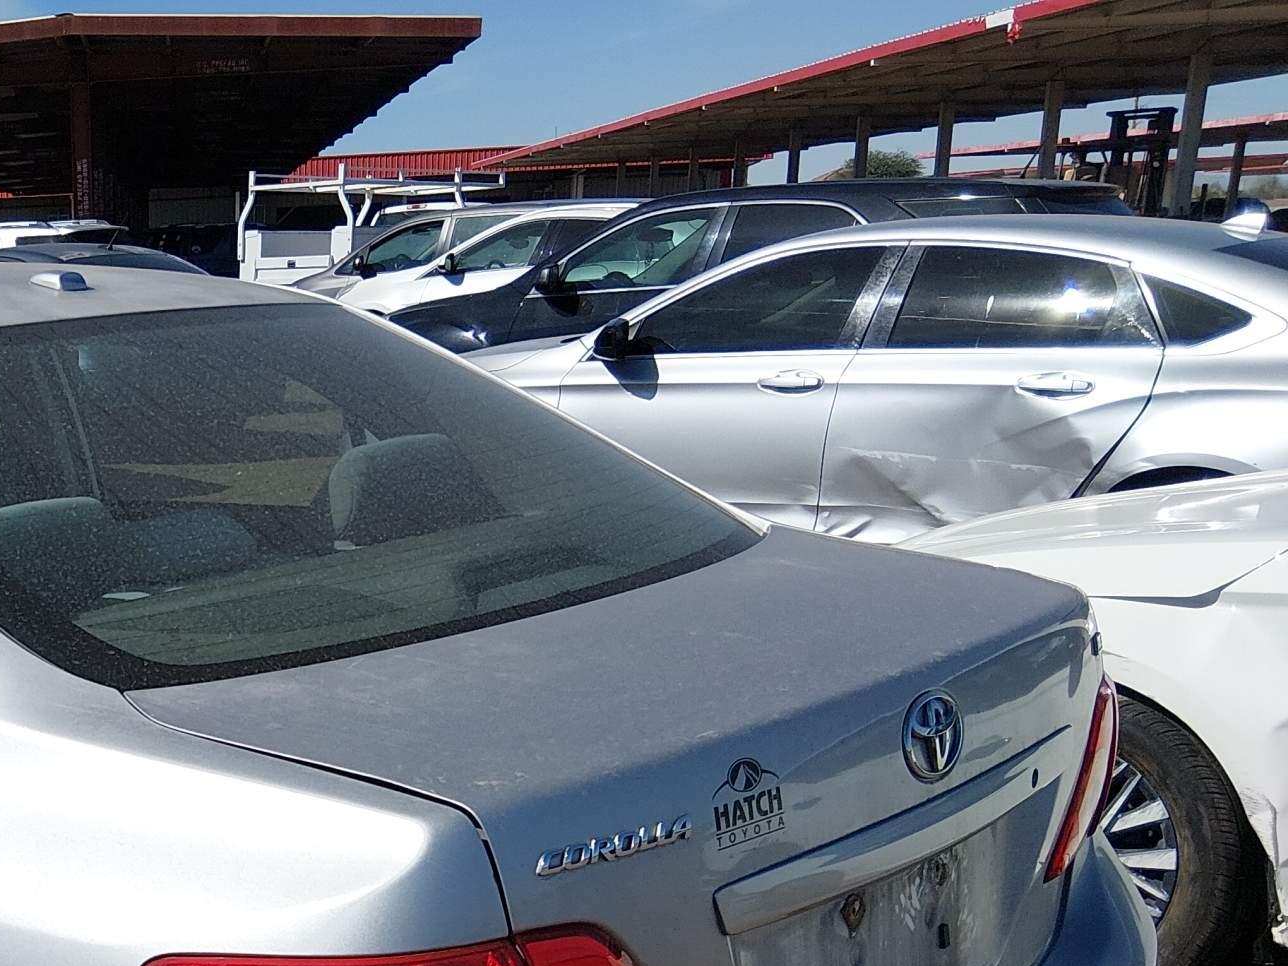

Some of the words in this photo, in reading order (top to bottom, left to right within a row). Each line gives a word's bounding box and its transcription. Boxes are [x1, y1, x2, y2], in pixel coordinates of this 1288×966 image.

[713, 786, 783, 832] HATCH
[716, 816, 785, 848] TOYOTA
[535, 813, 692, 876] COROLLA
